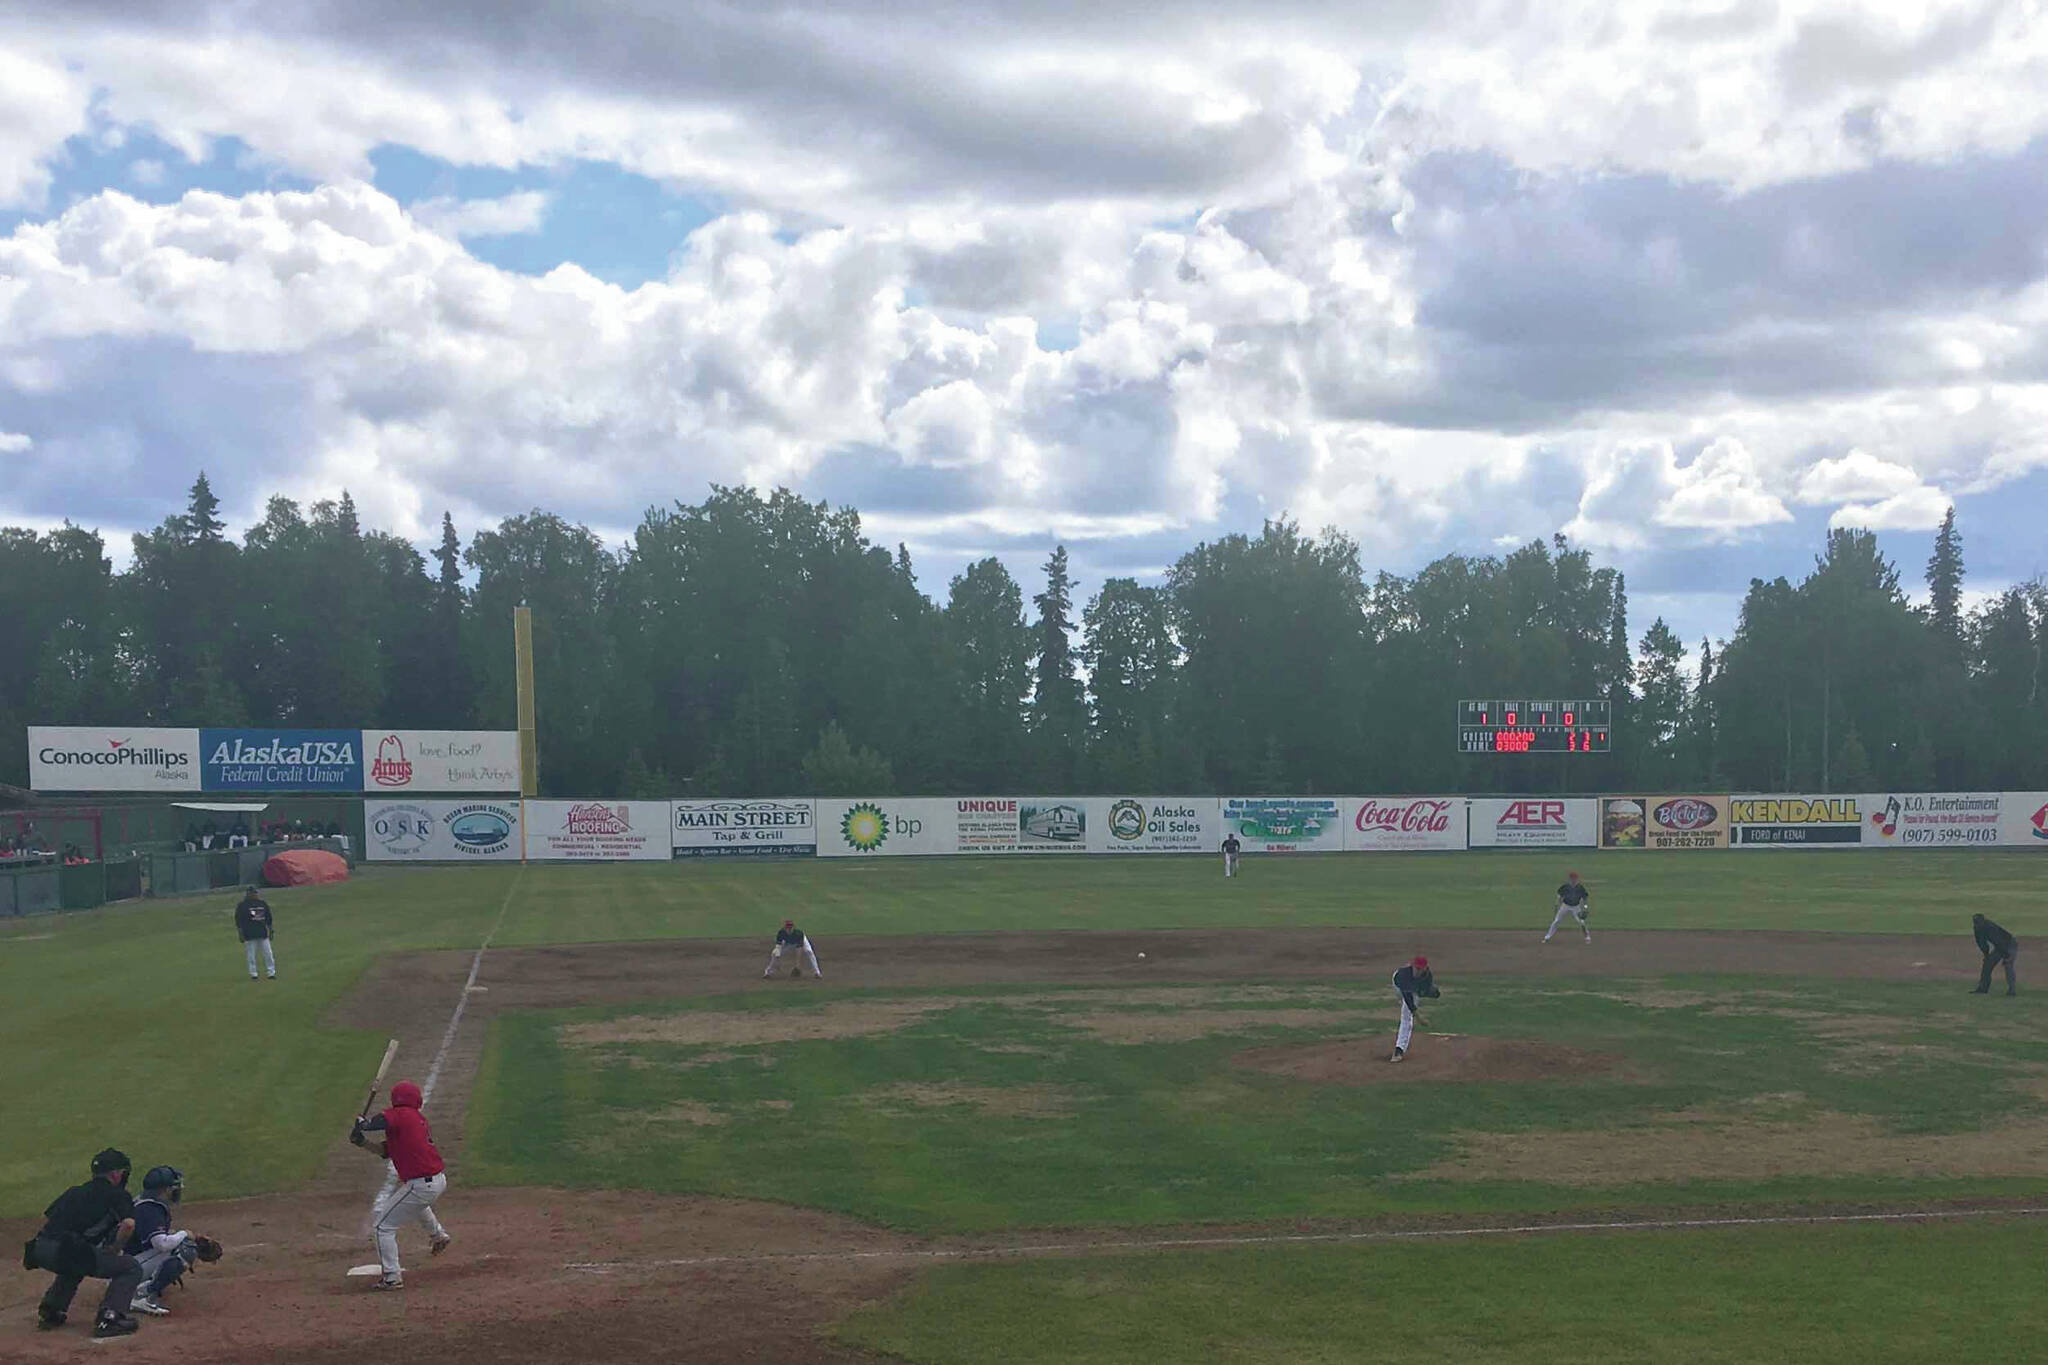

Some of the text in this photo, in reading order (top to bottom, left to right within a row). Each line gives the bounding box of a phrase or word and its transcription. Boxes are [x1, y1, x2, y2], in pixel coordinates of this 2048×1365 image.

[1507, 712, 1516, 725] 0
[1564, 712, 1573, 725] 0
[39, 747, 189, 769] ConocoPhillips
[208, 738, 355, 765] AlaskaUSA
[154, 769, 189, 780] Alaska
[221, 766, 345, 782] Federal Credit Union
[957, 800, 1017, 812] UNIQUE
[1928, 795, 2000, 811] Entertainment
[1152, 805, 1195, 818] Alaska
[1356, 800, 1452, 832] Coca-Cola
[1497, 801, 1565, 824] AER
[1731, 799, 1861, 823] KENDALL
[678, 811, 810, 827] MAIN STREET
[570, 821, 620, 834] ROOFING
[895, 815, 922, 838] bp
[1147, 820, 1201, 833] Oil Sales
[712, 830, 783, 841] Tap & Grill
[1751, 830, 1770, 840] FORD
[1783, 830, 1806, 840] KENAI
[1902, 828, 1997, 842] (907) 599-0103
